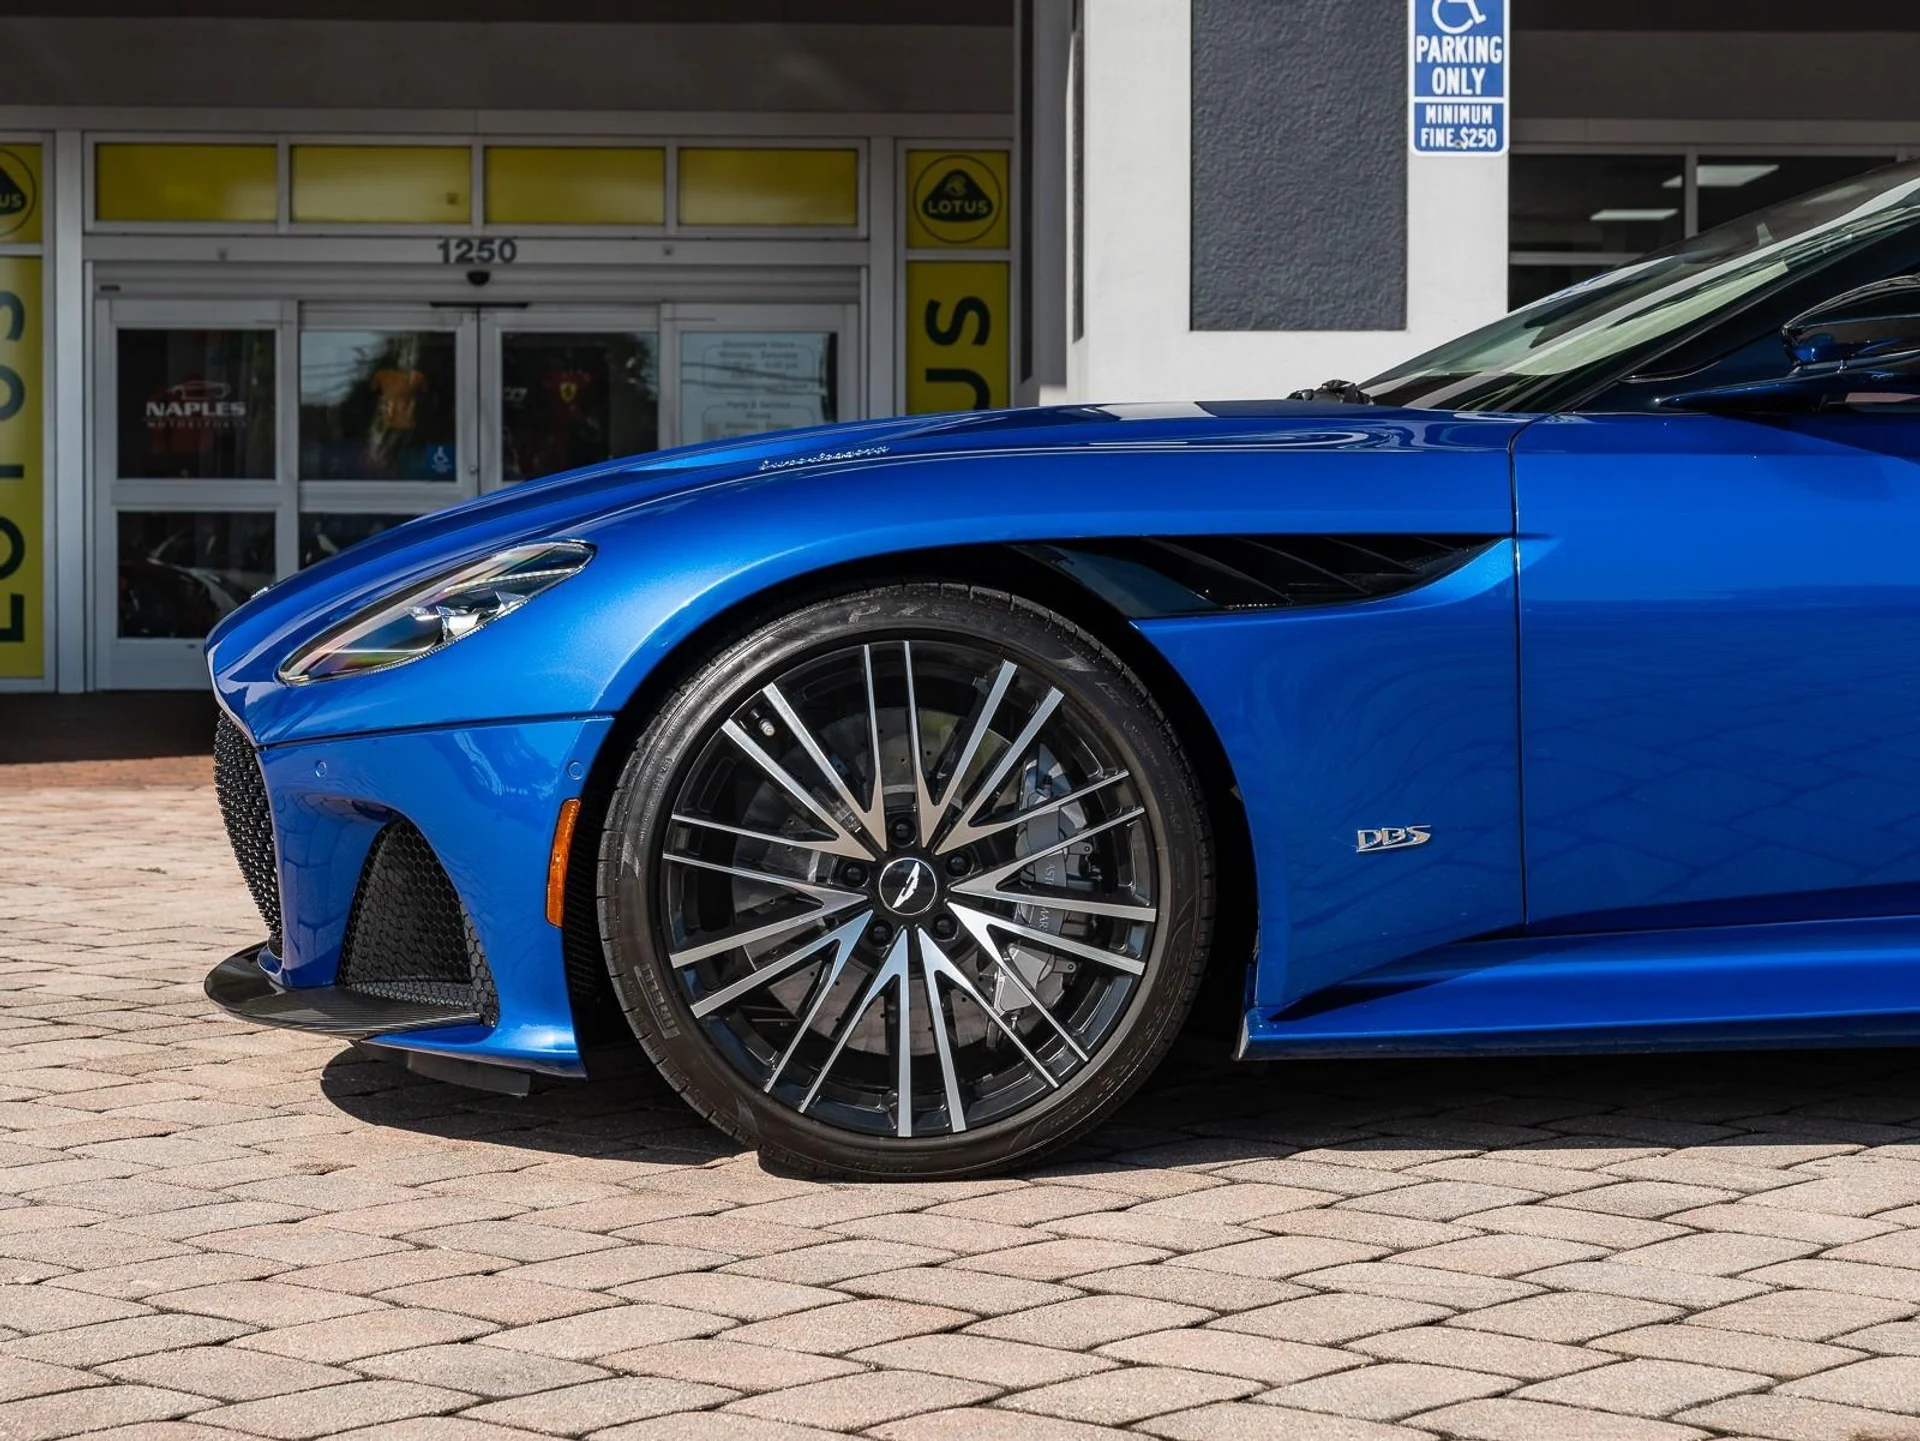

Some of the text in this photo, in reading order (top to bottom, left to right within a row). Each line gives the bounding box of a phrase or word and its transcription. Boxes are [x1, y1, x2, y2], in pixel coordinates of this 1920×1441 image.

[1416, 35, 1502, 63] PARKING
[1432, 67, 1486, 95] ONLY
[1425, 104, 1493, 124] MINIMUM
[1421, 126, 1497, 149] FINE $250
[928, 200, 988, 214] LOTUS
[437, 237, 517, 264] 1250
[146, 401, 247, 416] NAPLES
[1356, 825, 1431, 852] DBS
